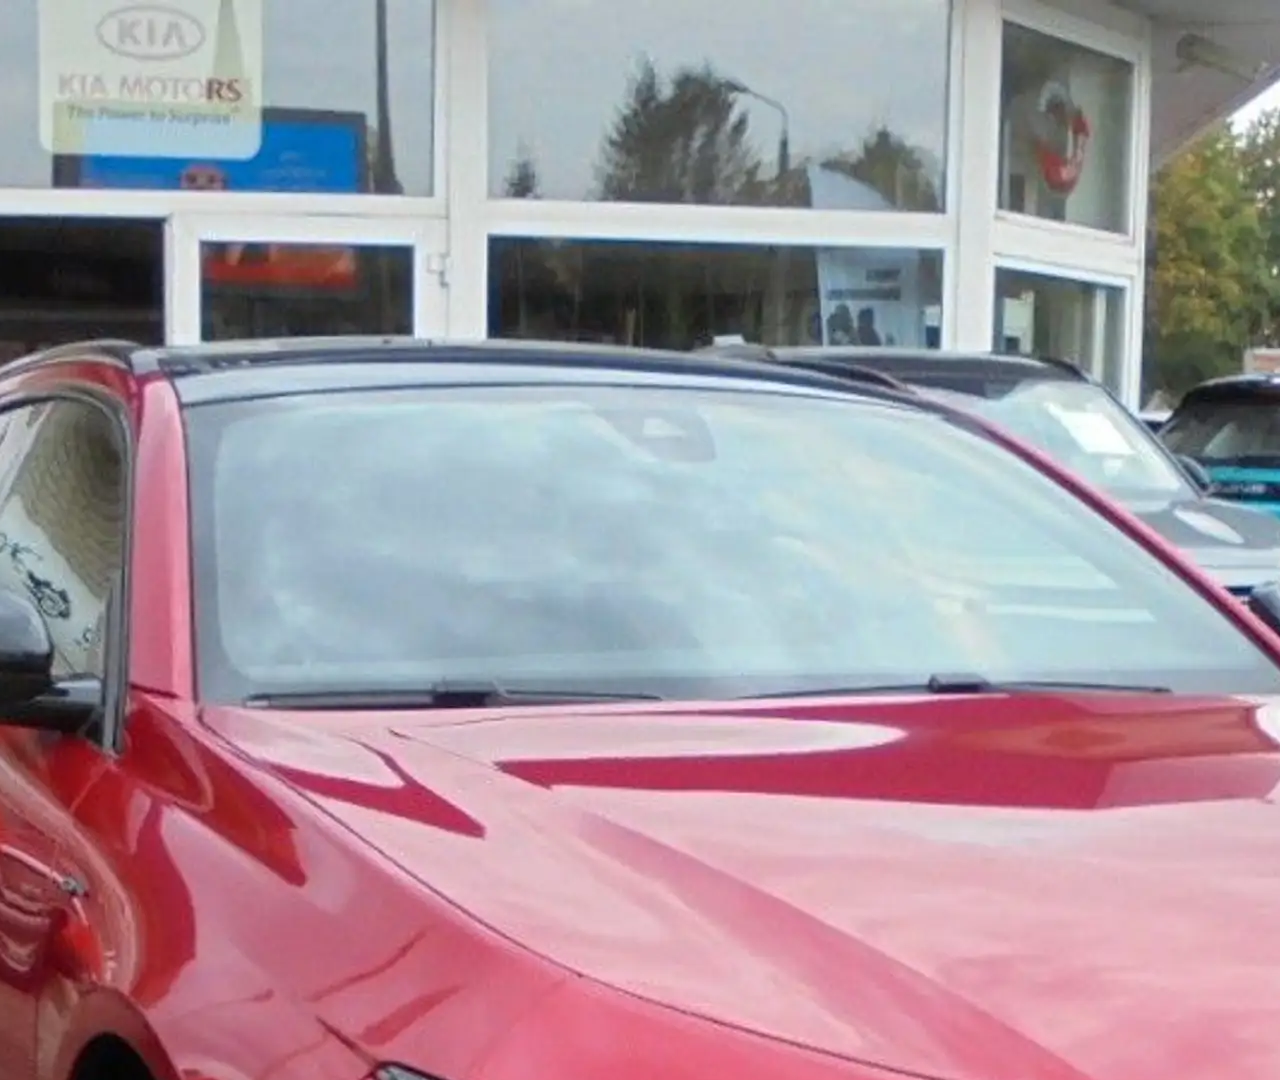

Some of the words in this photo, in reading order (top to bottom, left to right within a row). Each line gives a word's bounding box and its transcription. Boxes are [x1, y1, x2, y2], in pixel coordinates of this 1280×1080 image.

[117, 17, 187, 49] KIA
[57, 72, 109, 98] KIA
[119, 74, 244, 102] MOTORS
